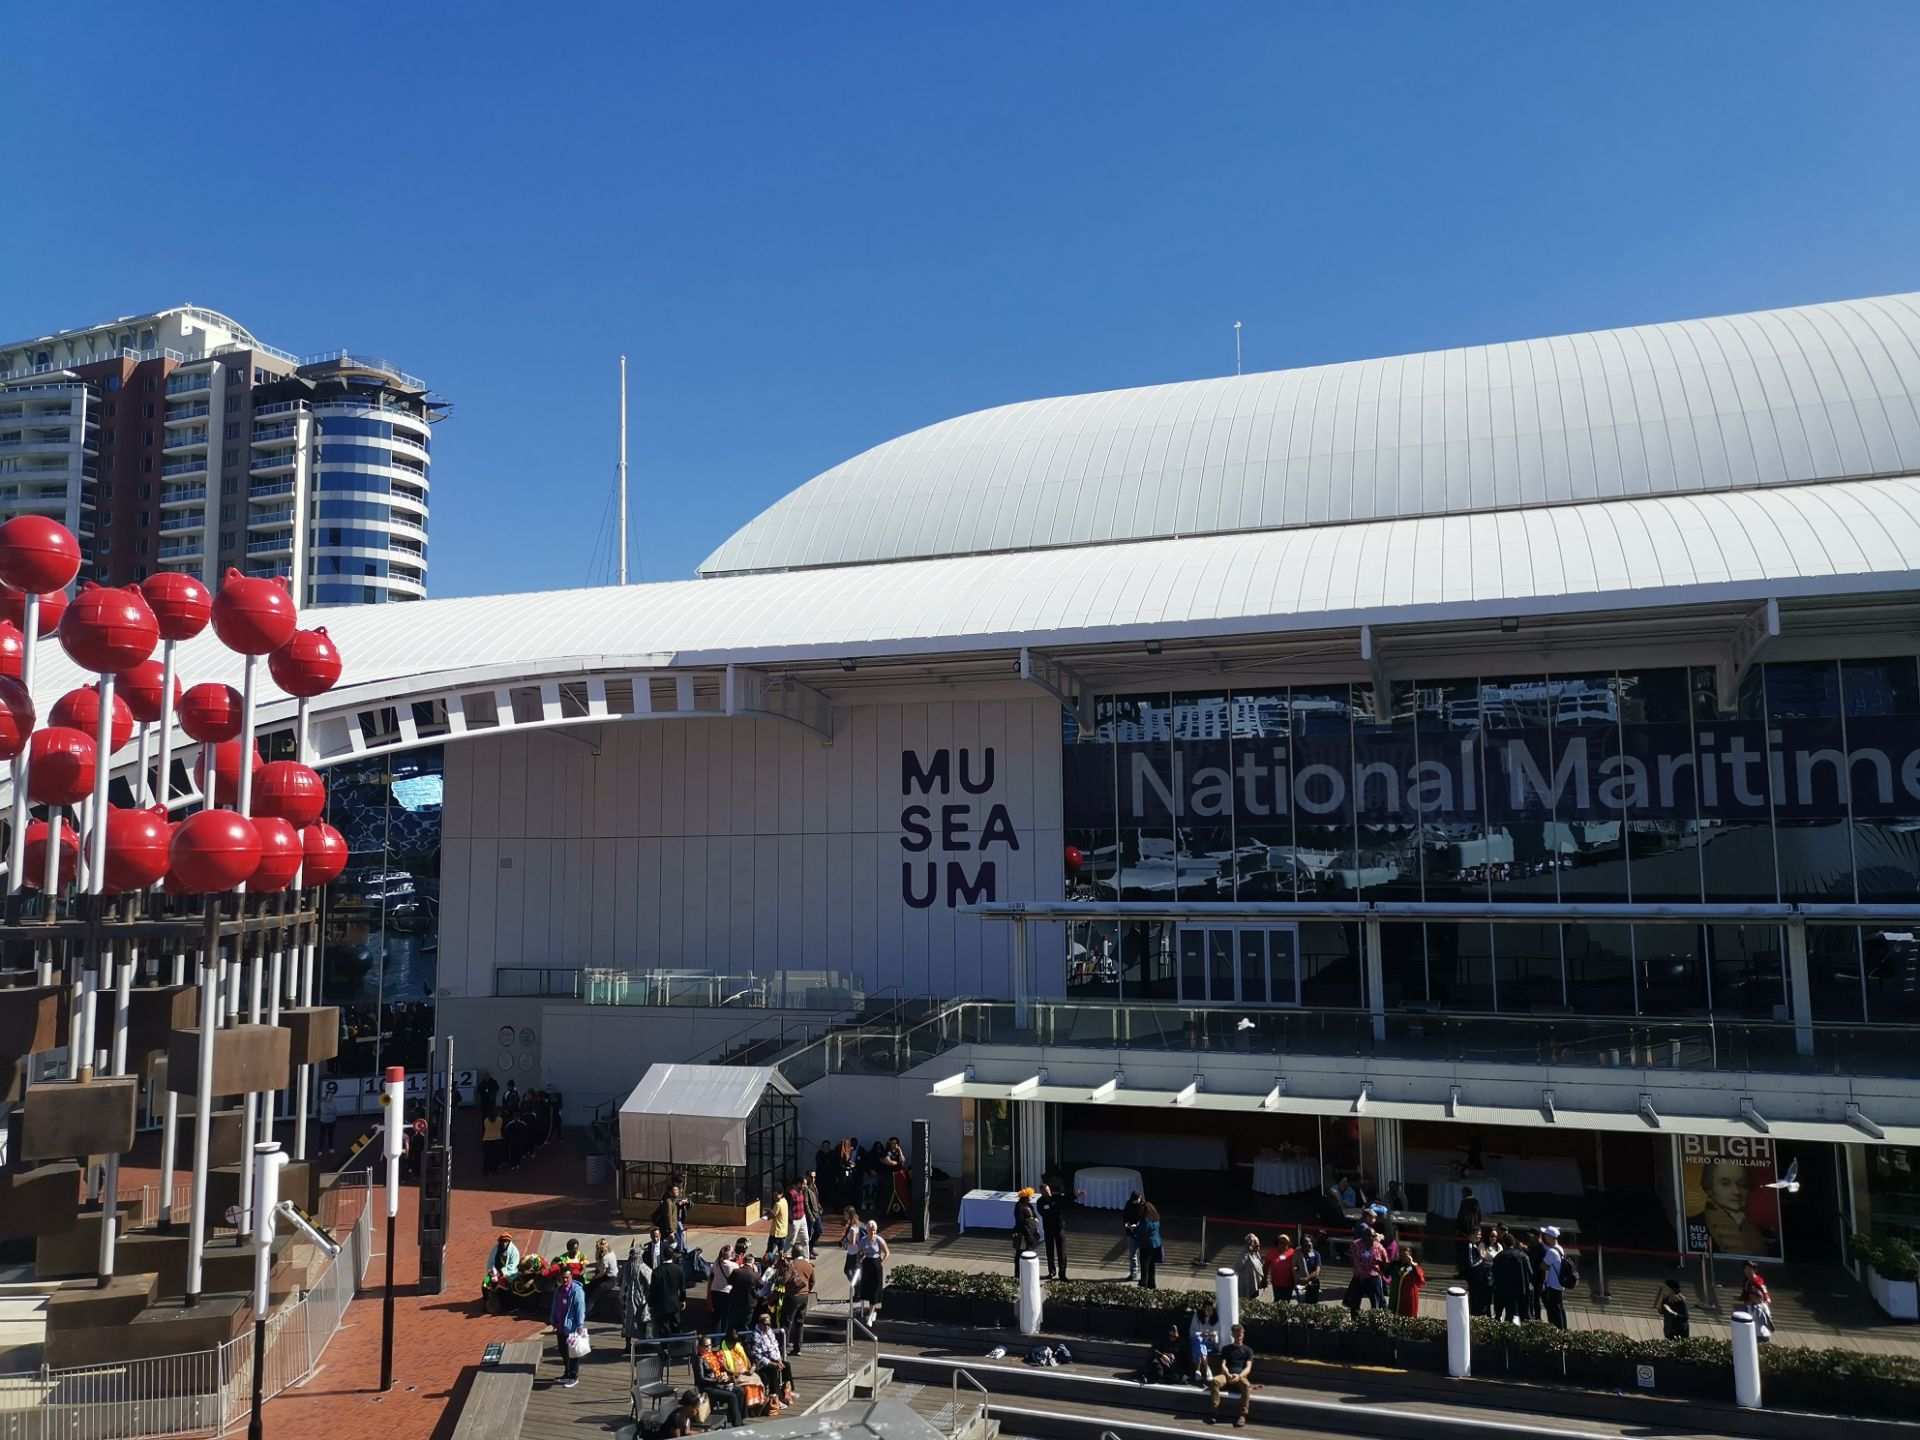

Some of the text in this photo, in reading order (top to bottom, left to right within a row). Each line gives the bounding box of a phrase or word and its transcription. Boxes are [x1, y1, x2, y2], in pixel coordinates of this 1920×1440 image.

[902, 747, 995, 795] MU
[1131, 739, 1477, 817] National
[900, 804, 1019, 852] SEA
[902, 861, 996, 908] UM
[326, 1081, 338, 1095] 9
[1684, 1134, 1770, 1158] BLIGH
